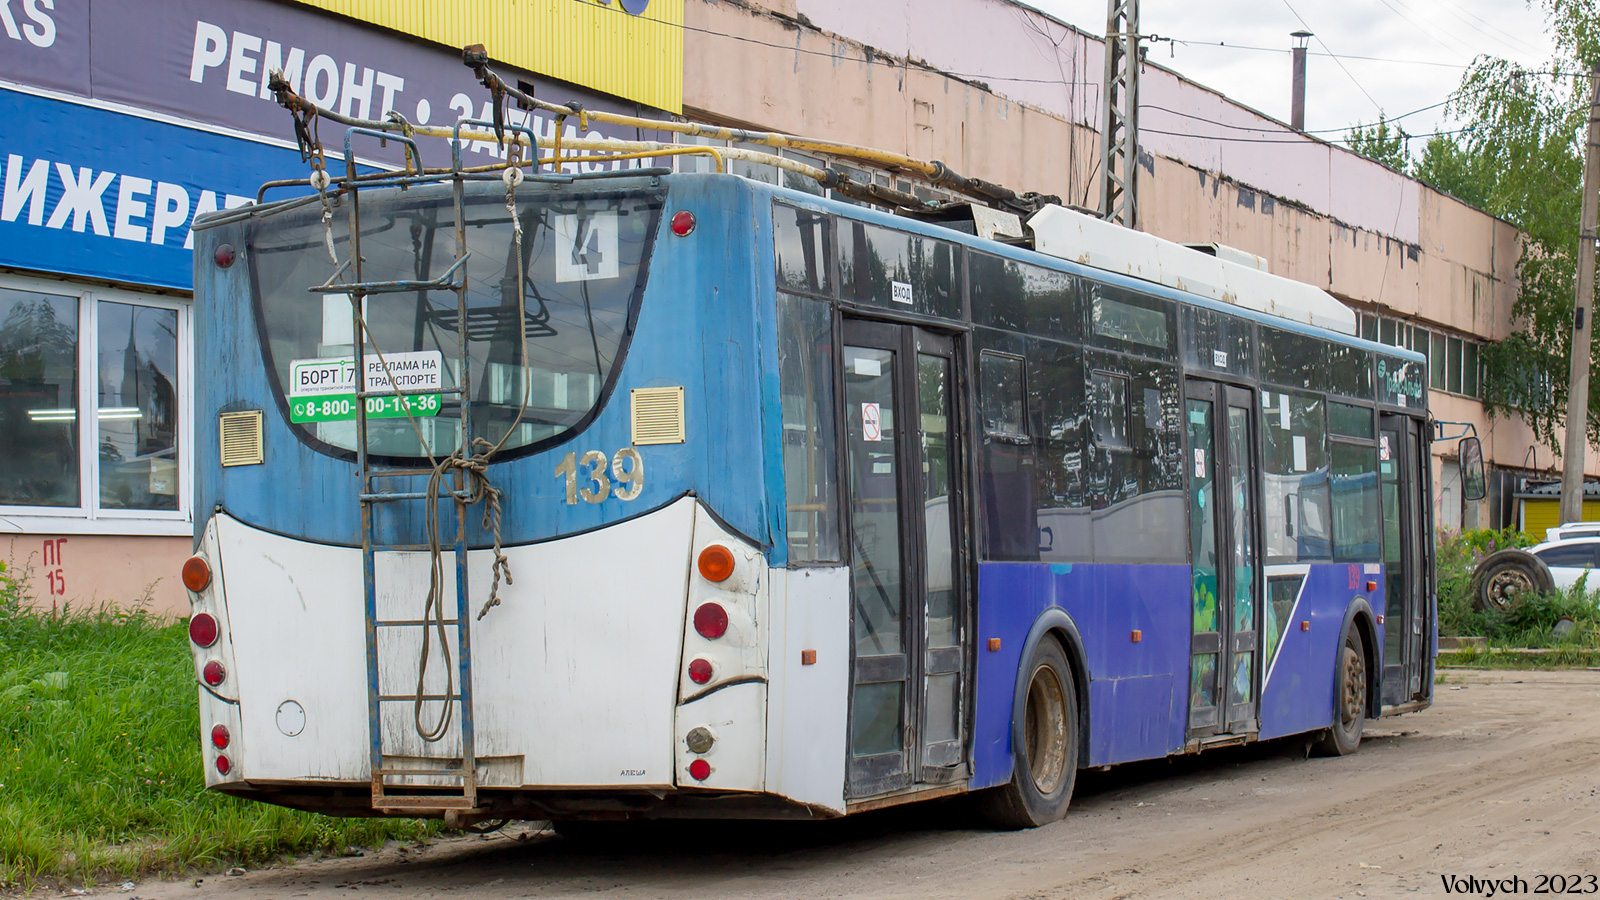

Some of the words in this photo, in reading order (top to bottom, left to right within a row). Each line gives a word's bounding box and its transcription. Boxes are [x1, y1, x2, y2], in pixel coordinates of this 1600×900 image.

[190, 20, 405, 122] РЕМОНТ
[893, 284, 911, 302] ВХОД
[301, 368, 339, 385] БОРТ
[368, 360, 420, 373] РЕКЛАМА
[422, 359, 437, 370] НА
[369, 373, 437, 387] ТРАНСПОРТЕ
[306, 395, 437, 417] 8-800-00-16-36
[555, 447, 644, 505] 139
[43, 538, 68, 567] ПГ
[47, 569, 65, 596] 15
[1348, 564, 1360, 590] 139
